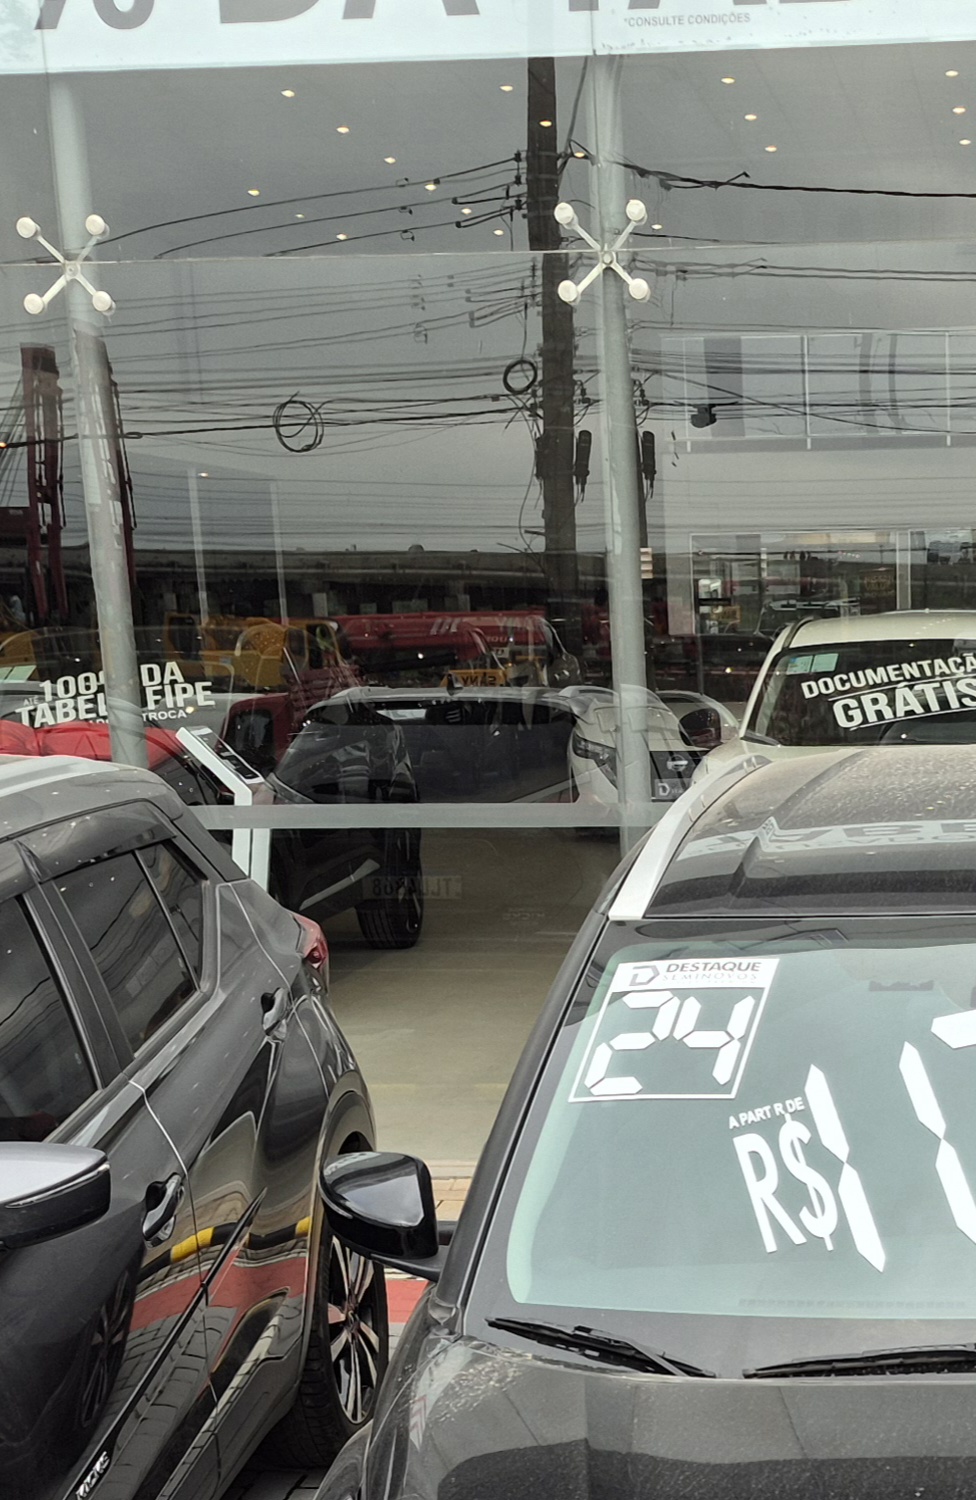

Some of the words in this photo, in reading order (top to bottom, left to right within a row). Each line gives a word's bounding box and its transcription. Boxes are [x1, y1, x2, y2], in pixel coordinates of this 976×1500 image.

[687, 12, 751, 26] CONDIÇÕES
[140, 661, 185, 687] DA
[15, 692, 109, 728] TABEL
[145, 681, 216, 711] FIPE
[665, 961, 762, 973] DESTAQUE
[584, 990, 755, 1096] 24
[728, 1115, 740, 1130] A
[784, 1096, 806, 1114] DE
